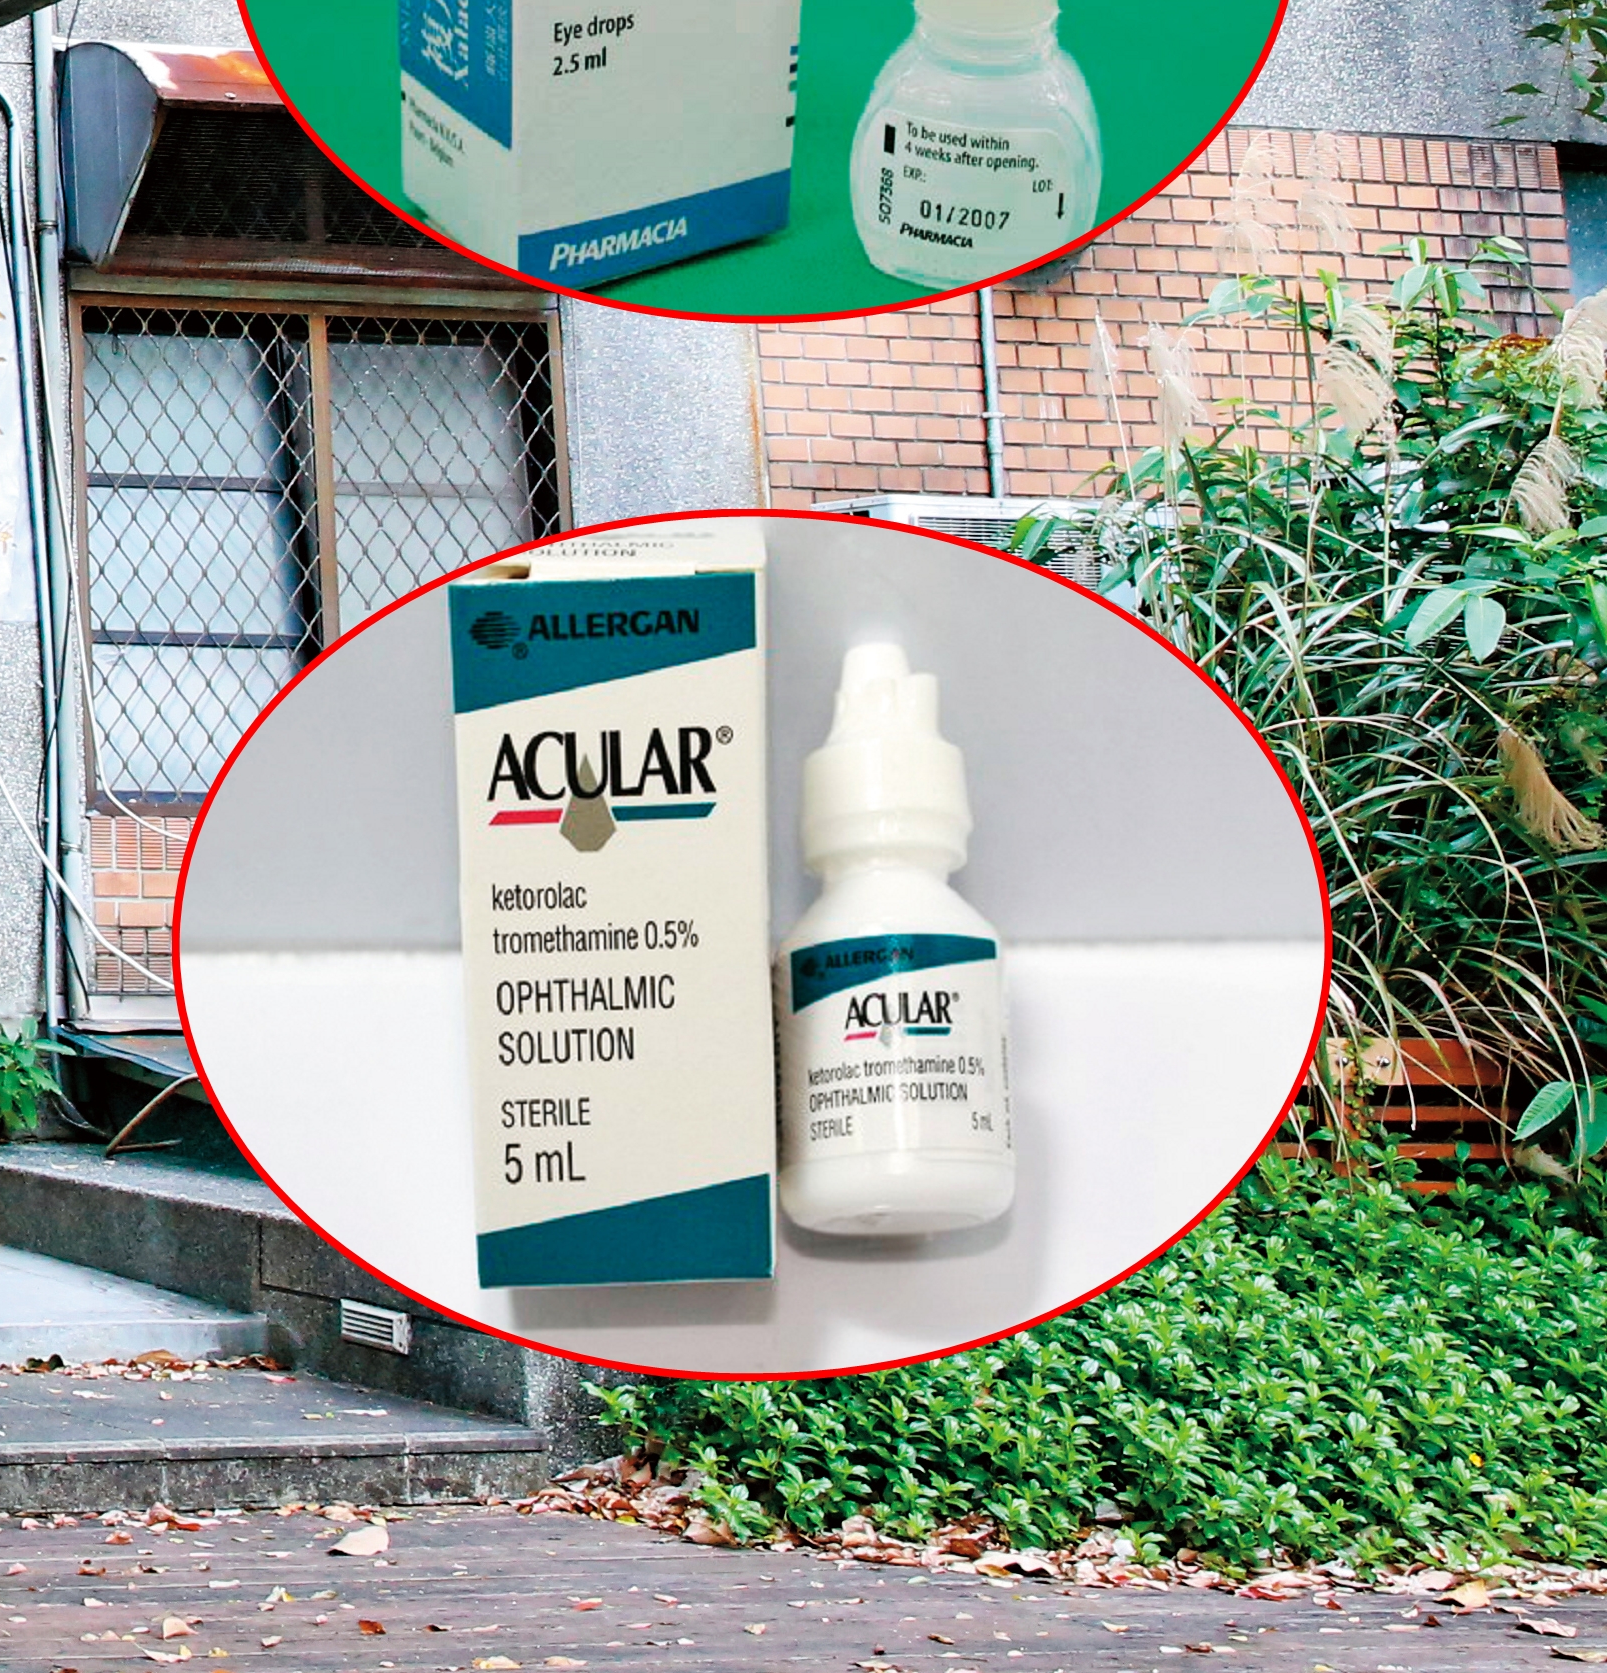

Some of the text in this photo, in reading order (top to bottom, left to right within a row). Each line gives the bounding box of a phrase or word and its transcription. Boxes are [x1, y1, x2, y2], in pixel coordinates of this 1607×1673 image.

[553, 12, 635, 44] Eye drops
[553, 47, 607, 76] 2.5 ml
[906, 122, 1010, 150] To be used within
[905, 141, 1039, 172] 4 weeks after opening.
[920, 199, 1011, 230] 01/2007
[549, 217, 689, 271] PHARMACIA
[900, 223, 974, 248] PHARMACIA
[528, 609, 699, 641] ALLERGAN
[492, 881, 588, 911] ketorolac
[493, 919, 699, 955] tromethamine 0.5%
[496, 974, 676, 1016] OPHTHALMIC
[498, 1026, 635, 1066] SOLUTION
[808, 1055, 985, 1086] ketorolac tromethamine 0.5%
[501, 1097, 592, 1128] STERILE
[809, 1082, 968, 1112] OPHTHALMIC SOLUTION
[809, 1116, 853, 1141] STERILE
[971, 1112, 979, 1130] 5
[504, 1141, 586, 1184] 5 mL
